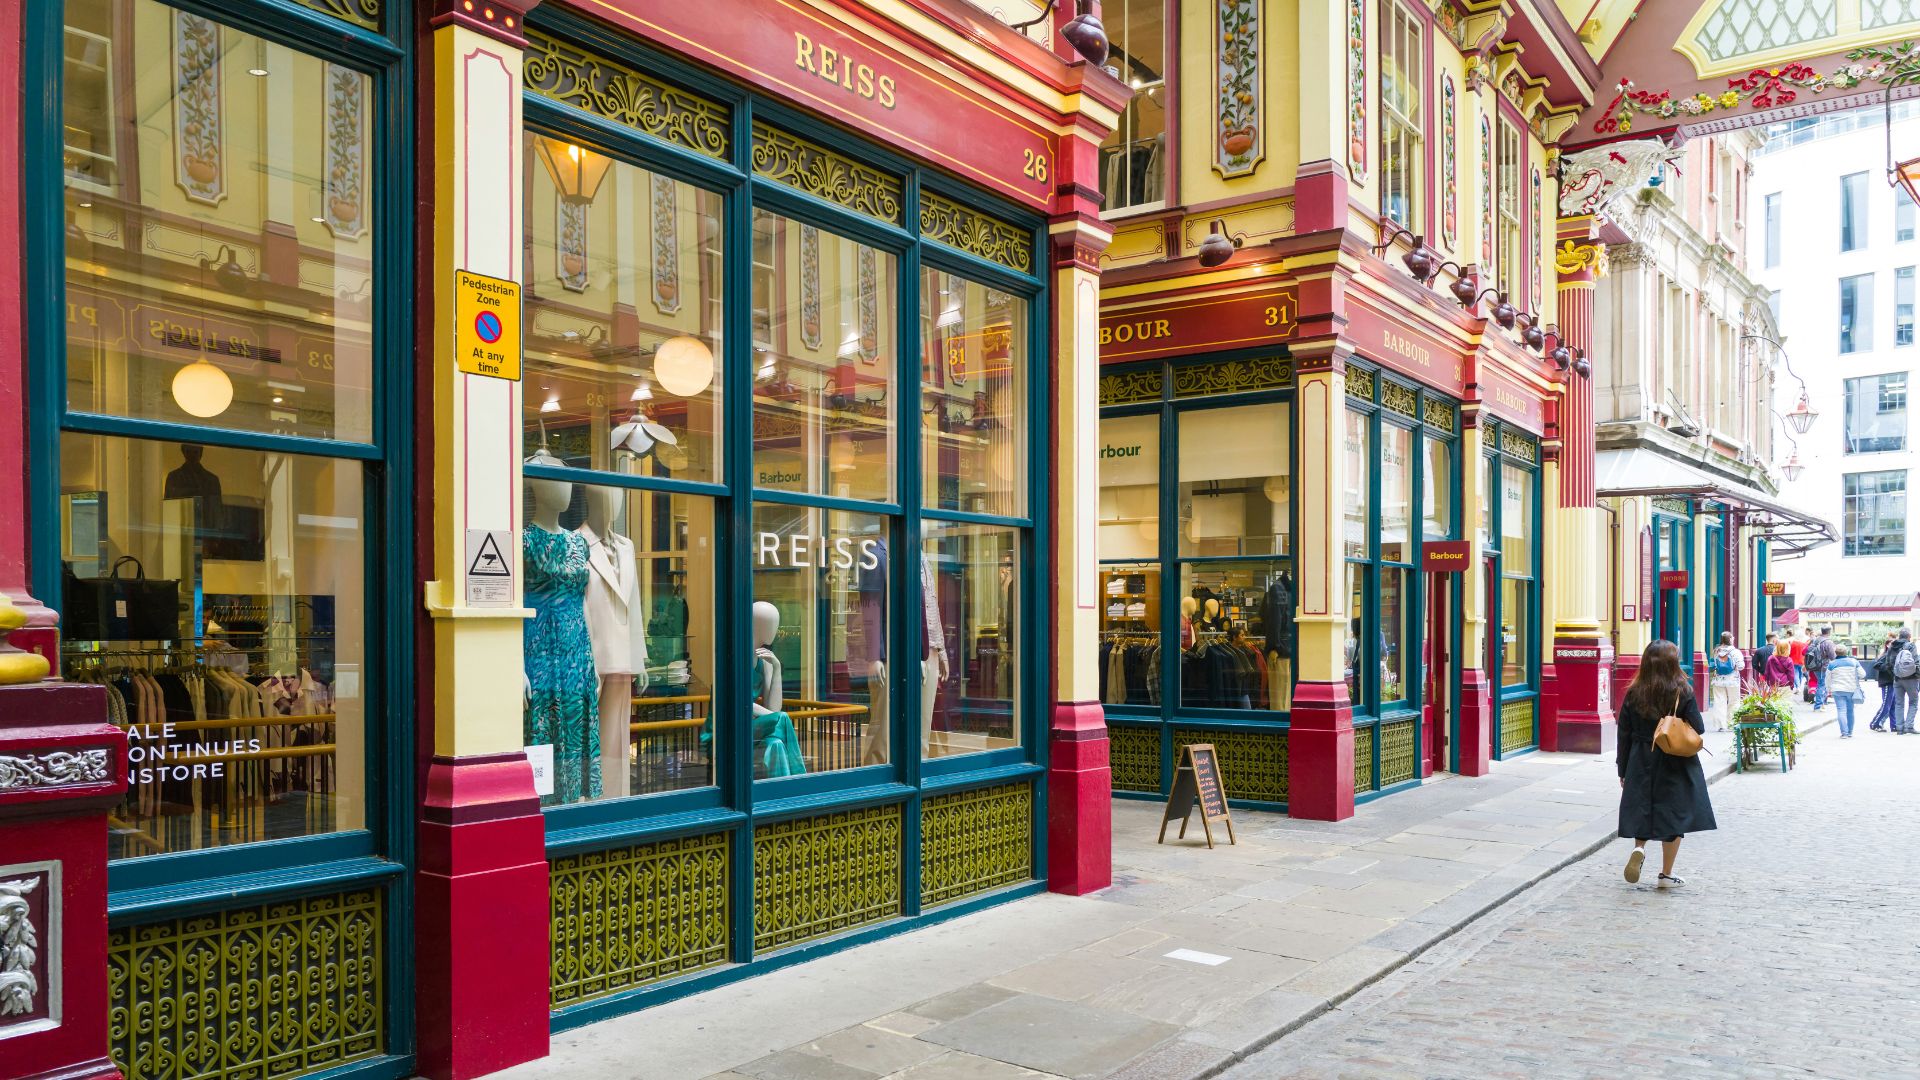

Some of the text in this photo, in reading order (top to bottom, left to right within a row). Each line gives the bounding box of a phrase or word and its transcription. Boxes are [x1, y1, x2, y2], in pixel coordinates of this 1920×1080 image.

[794, 32, 1048, 184] REISS 26
[462, 276, 515, 297] Pedestrian
[476, 293, 501, 306] Zone
[1099, 306, 1289, 345] BOUR 31
[473, 347, 505, 364] At any
[948, 348, 966, 366] 31
[1383, 329, 1431, 368] BARBOUR
[1454, 364, 1462, 382] 31
[478, 362, 499, 374] time
[1496, 387, 1527, 415] BARBOUR
[1099, 444, 1142, 458] rbour
[759, 471, 802, 484] Barbour
[758, 532, 878, 570] REISS
[1430, 552, 1464, 560] Barbour
[1808, 611, 1850, 619] GIORGIO
[128, 722, 177, 740] ALE
[128, 738, 261, 763] ONTINUES
